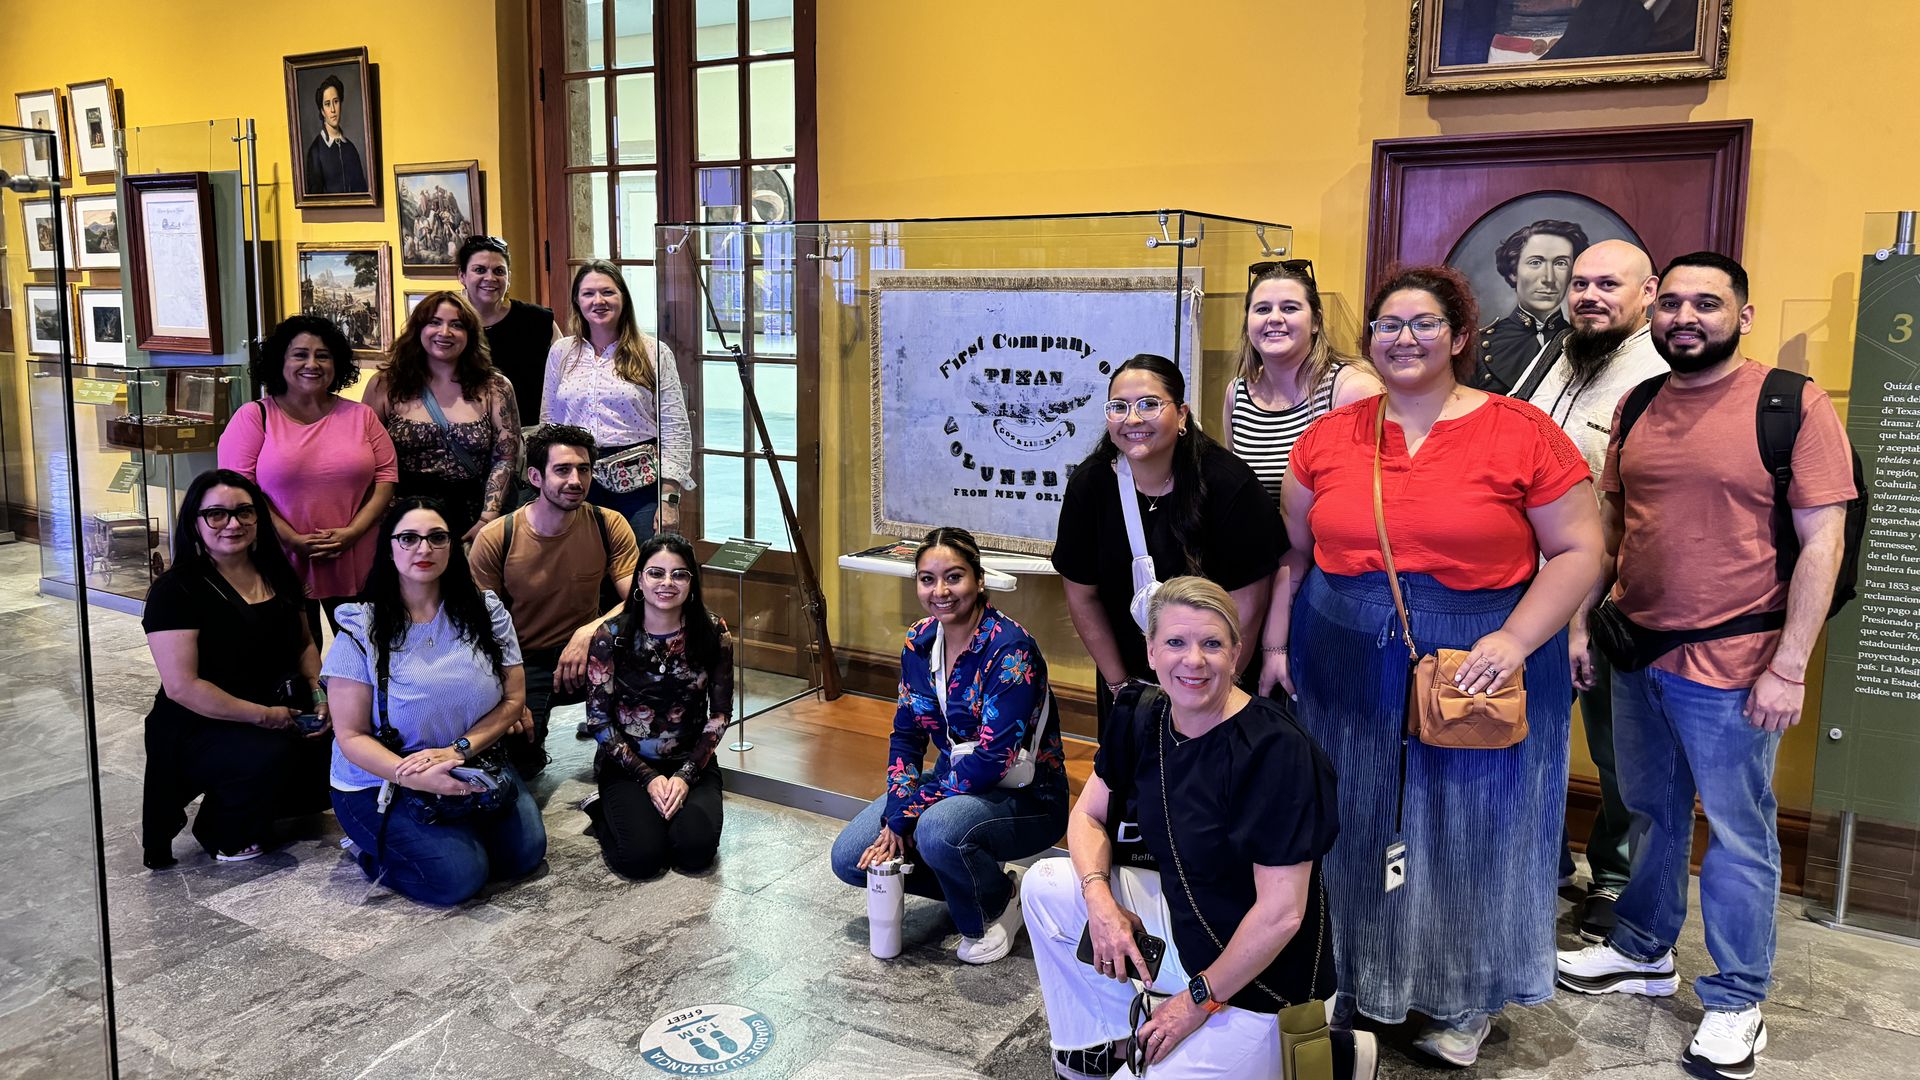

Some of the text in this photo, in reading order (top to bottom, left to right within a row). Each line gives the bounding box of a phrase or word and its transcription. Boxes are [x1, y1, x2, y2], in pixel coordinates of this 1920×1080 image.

[1887, 313, 1913, 343] 3
[939, 335, 985, 379] First
[992, 333, 1096, 359] Company
[1884, 382, 1912, 391] Quizá
[1895, 407, 1920, 416] Texas
[1880, 419, 1914, 428] drama:
[1879, 432, 1897, 440] que
[1877, 456, 1910, 464] rebeldes
[1876, 467, 1919, 478] la región,
[1874, 479, 1917, 489] Coahuila
[954, 488, 1063, 502] FROM NEW ORL
[1873, 492, 1920, 502] voluntarios
[1869, 529, 1917, 540] cantinas y
[1869, 539, 1918, 551] Tennessee,
[1881, 553, 1898, 561] ello
[1866, 563, 1904, 574] bandera
[1865, 579, 1886, 588] Para
[1888, 581, 1909, 590] 1853
[1864, 592, 1920, 604] reclamacion
[1862, 604, 1885, 613] cuyo
[1887, 607, 1910, 616] pago
[1862, 614, 1913, 627] Presionado
[1860, 628, 1878, 637] que
[1879, 630, 1905, 638] ceder
[1858, 651, 1910, 663] proyectado
[1857, 663, 1878, 671] país.
[1880, 664, 1892, 673] La
[1856, 674, 1881, 683] venta
[1855, 686, 1890, 697] cedidos
[1891, 691, 1903, 699] en
[667, 1012, 694, 1026] FEET
[677, 1021, 719, 1040] 1.9 M
[649, 1019, 770, 1074] GUARDE SU DISTANCIA
